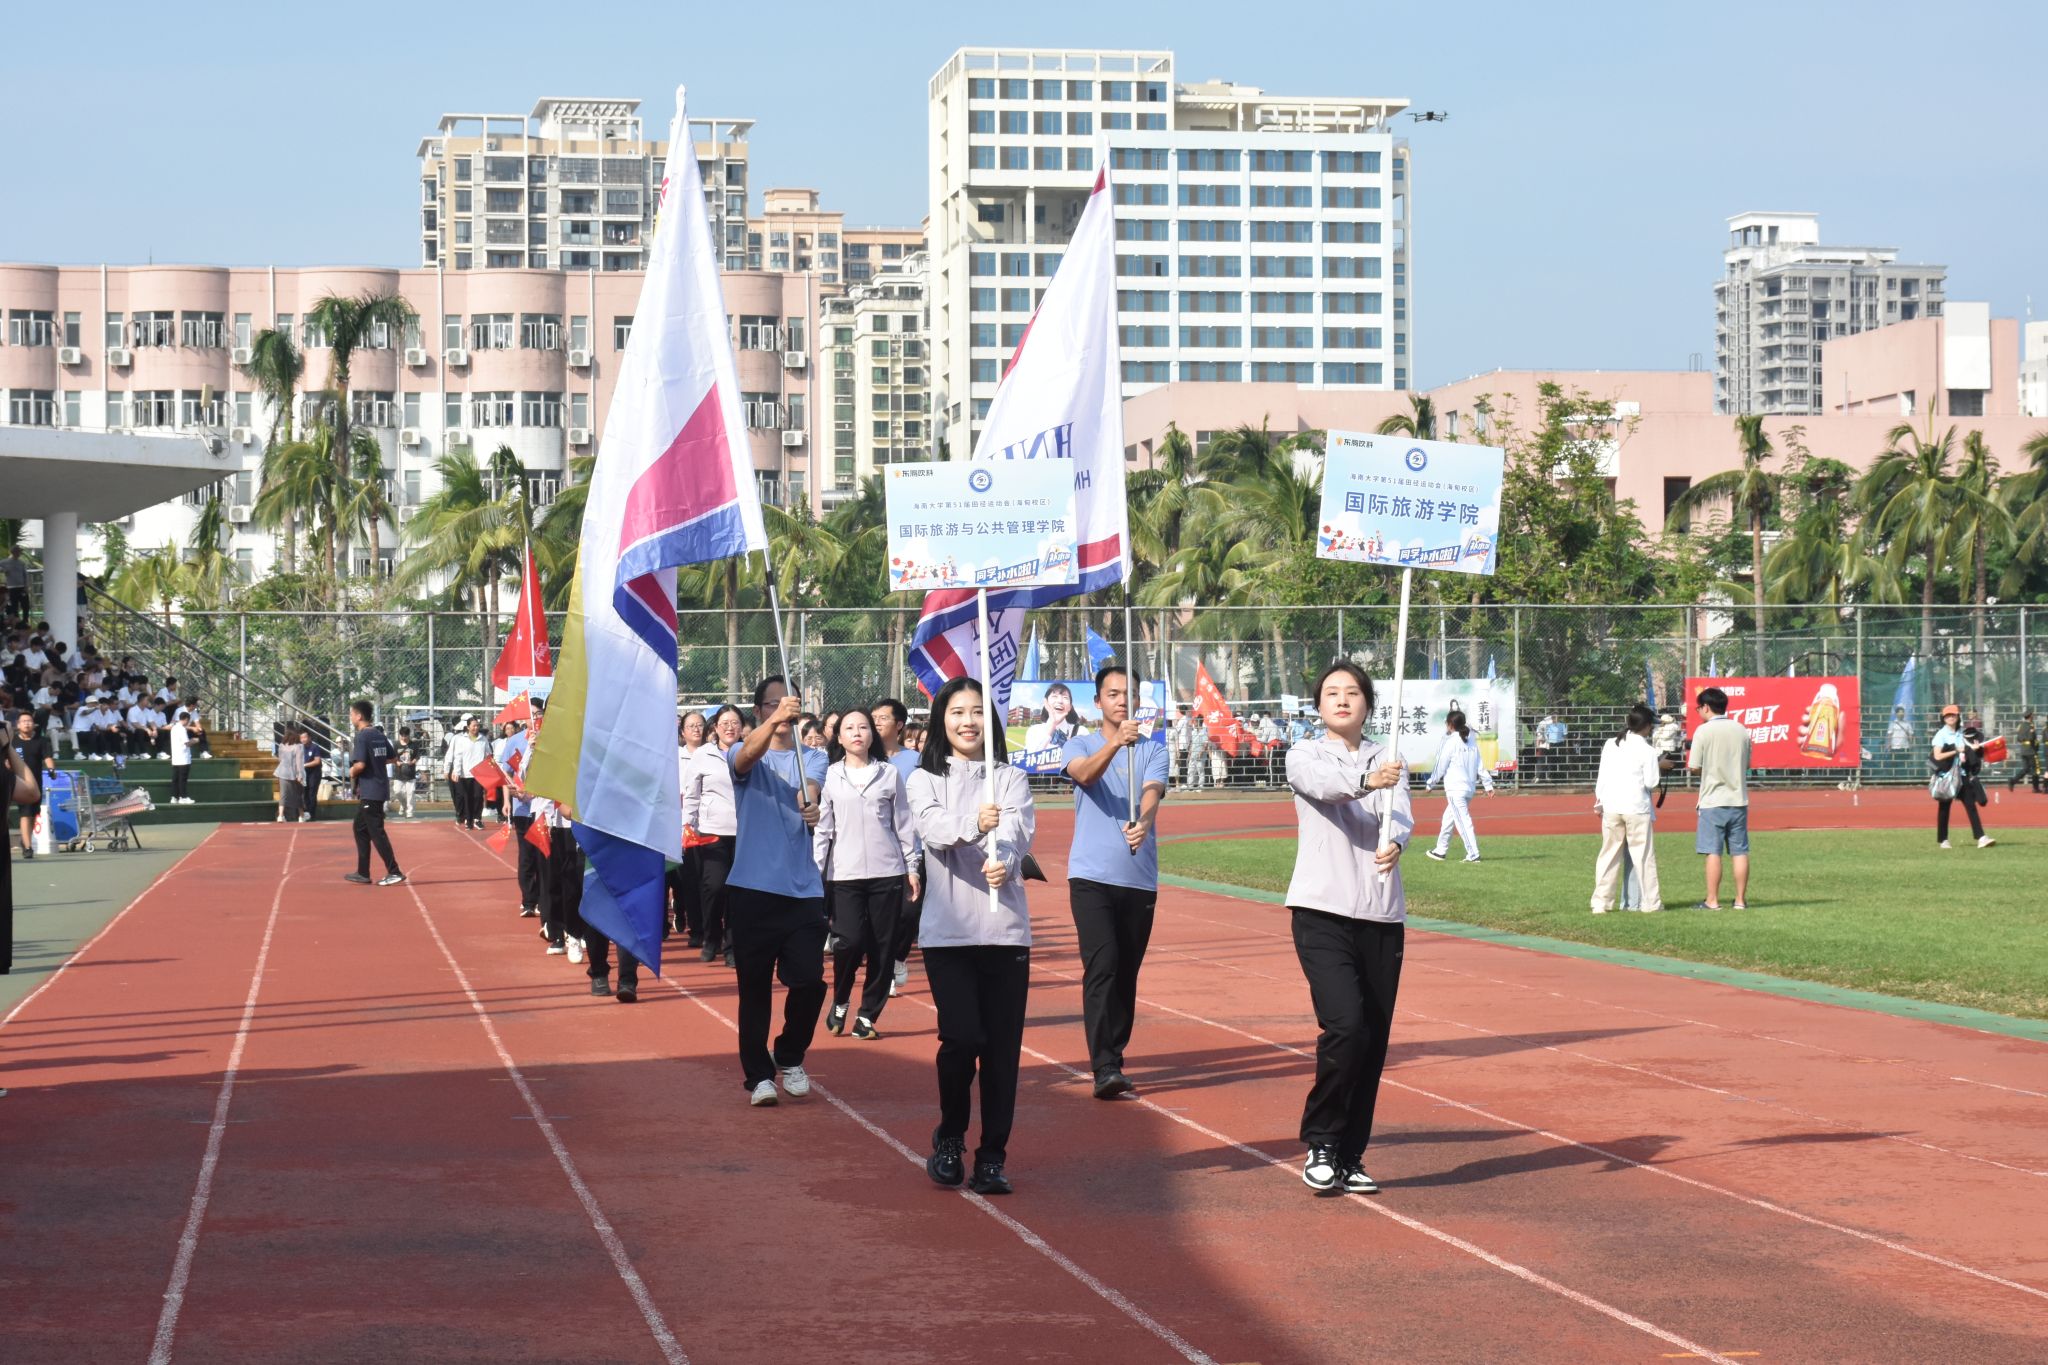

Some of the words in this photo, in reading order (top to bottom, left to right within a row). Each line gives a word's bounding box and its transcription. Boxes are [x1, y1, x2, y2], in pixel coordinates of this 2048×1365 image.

[1345, 491, 1479, 525] 国际旅游学院
[900, 519, 1065, 538] 国际旅游与公共管理学院
